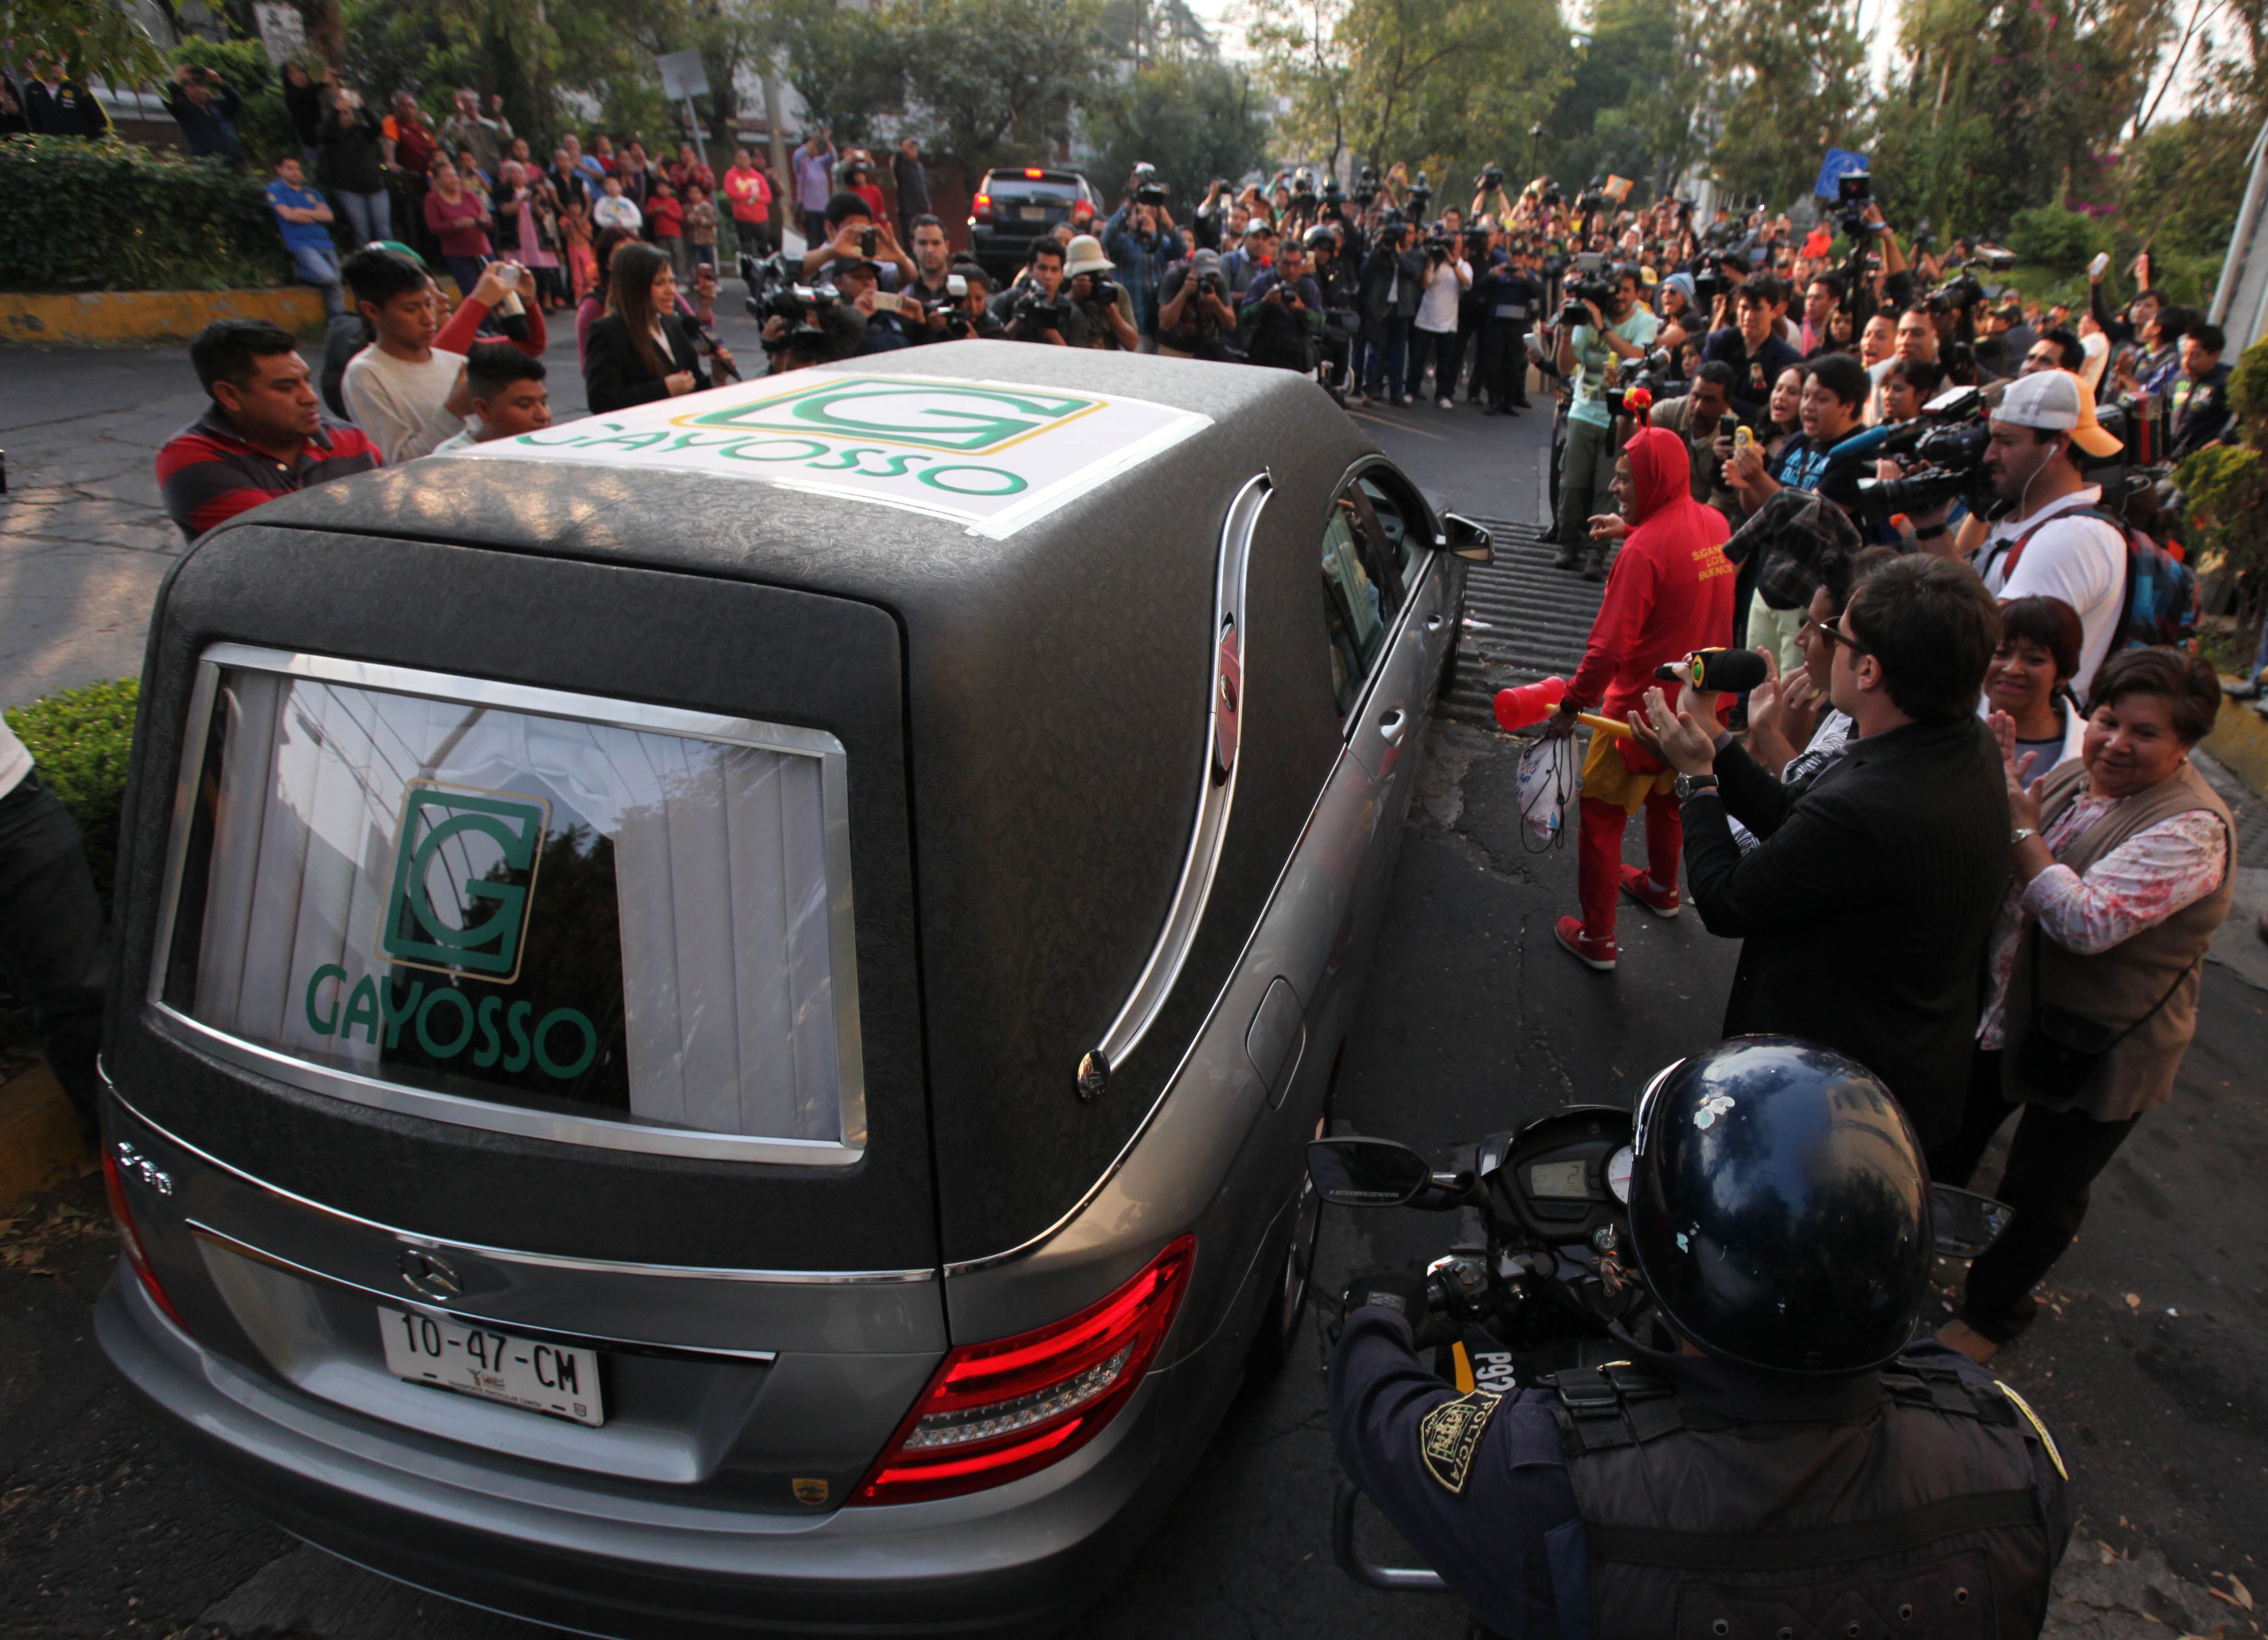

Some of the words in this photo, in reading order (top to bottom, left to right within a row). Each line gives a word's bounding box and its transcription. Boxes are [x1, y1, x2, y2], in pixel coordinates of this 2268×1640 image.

[515, 424, 1028, 495] GAYOSSO
[1706, 554, 1725, 567] LOS
[306, 963, 597, 1079] GAYOSSO
[402, 1314, 579, 1395] 10-47-CM
[1450, 1401, 1494, 1481] POLICIA
